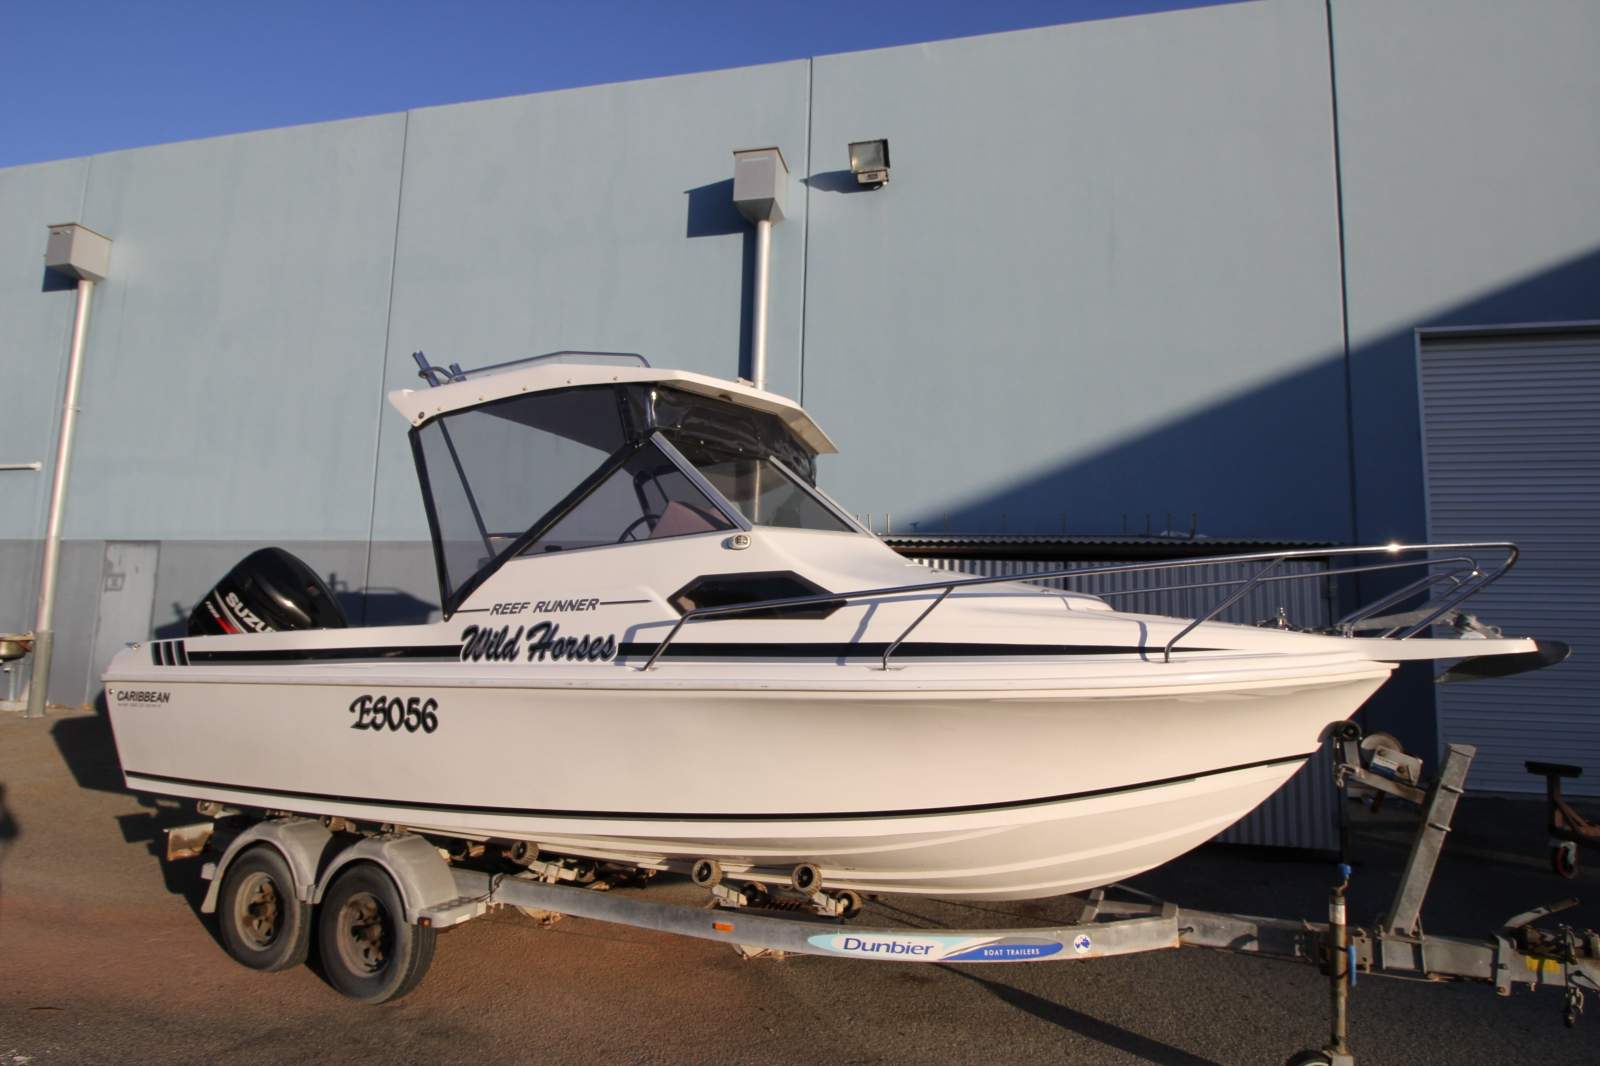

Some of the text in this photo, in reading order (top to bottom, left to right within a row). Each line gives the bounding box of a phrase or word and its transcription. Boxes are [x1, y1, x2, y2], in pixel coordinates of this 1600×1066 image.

[226, 592, 277, 633] SUZU
[490, 598, 600, 616] REEF RUNNER
[461, 620, 617, 662] Wild Horses
[117, 690, 171, 704] CARIBBEAN
[349, 694, 439, 734] ES056
[843, 937, 935, 955] Dunbier
[1006, 948, 1040, 956] TRAILERS
